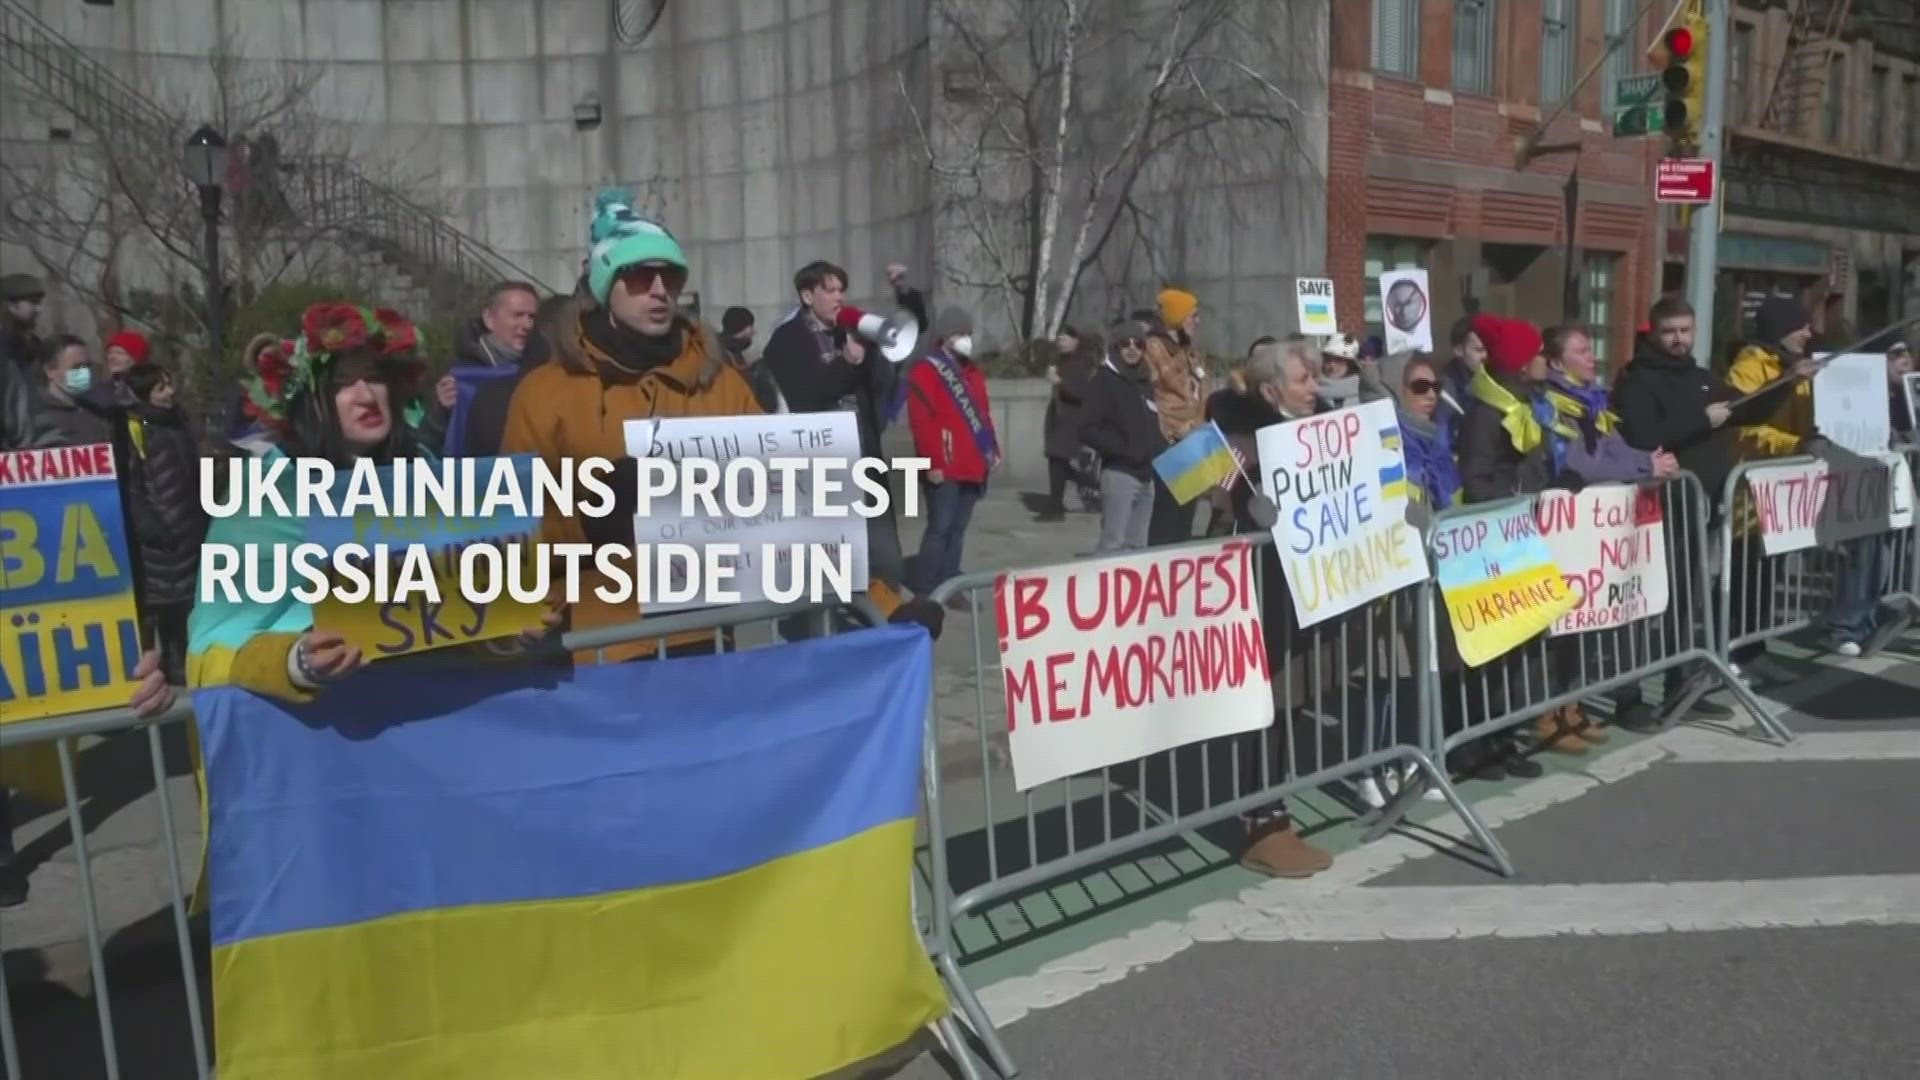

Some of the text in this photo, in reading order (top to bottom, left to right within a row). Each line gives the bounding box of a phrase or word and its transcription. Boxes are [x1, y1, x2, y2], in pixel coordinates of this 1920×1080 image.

[1299, 281, 1331, 297] SAVE
[758, 432, 779, 454] IS
[792, 427, 834, 451] THE
[1296, 413, 1361, 468] STOP
[1273, 457, 1354, 510] PUTIN
[1290, 483, 1373, 554] SAVE
[1435, 520, 1489, 560] STOP
[1537, 495, 1577, 537] UN
[1291, 524, 1412, 613] UKRAINE
[1004, 617, 1272, 733] MEMORANDUM
